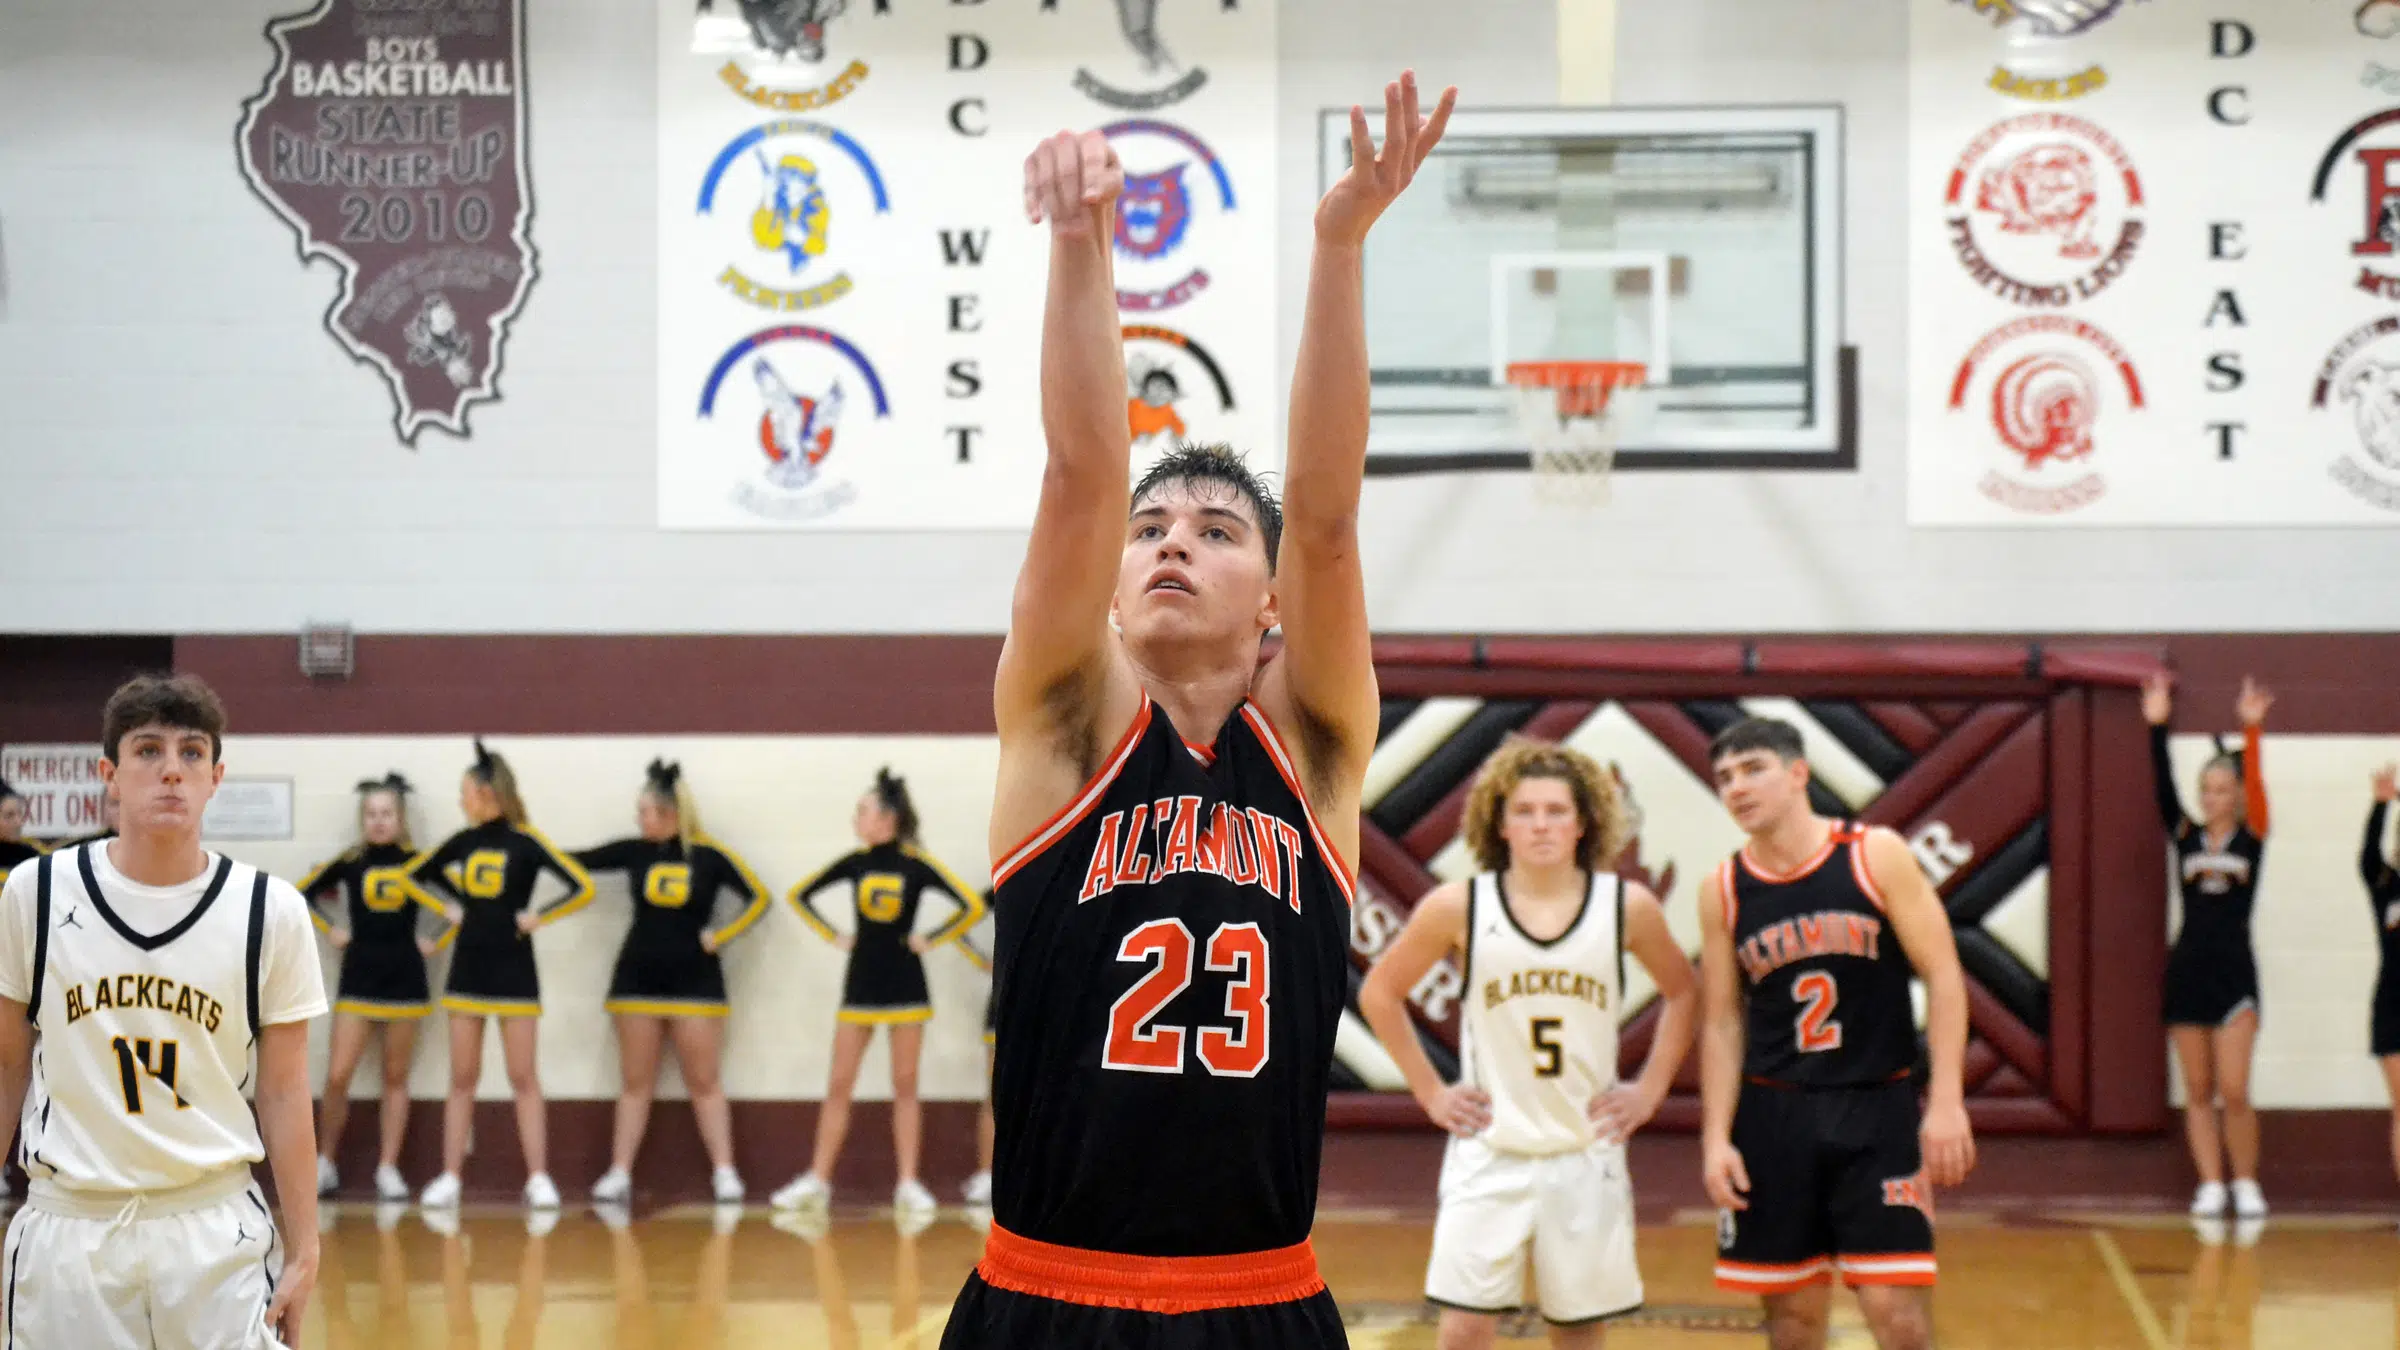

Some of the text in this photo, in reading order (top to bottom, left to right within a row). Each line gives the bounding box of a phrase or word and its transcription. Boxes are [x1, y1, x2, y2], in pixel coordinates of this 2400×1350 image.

[292, 60, 513, 97] BASKETBALL
[366, 37, 437, 63] BOYS
[316, 101, 460, 145] STATE
[269, 121, 506, 188] RUNNER-UP
[340, 189, 494, 243] 2010
[1947, 215, 2145, 308] FIGHTING LIONS
[937, 228, 992, 464] WEST
[2203, 222, 2250, 461] EAST
[5, 756, 98, 783] EMERGEN
[66, 790, 98, 826] ON
[465, 850, 508, 897] G
[1078, 795, 1302, 915] ALTAMONT
[645, 863, 691, 908] G
[858, 873, 904, 922] G
[65, 973, 223, 1035] BLACKCATS
[1101, 917, 1270, 1078] 23
[1484, 968, 1607, 1012] BLACKCATS
[1790, 969, 1842, 1053] 2
[110, 1033, 192, 1116] 14
[1529, 1016, 1564, 1078] 5
